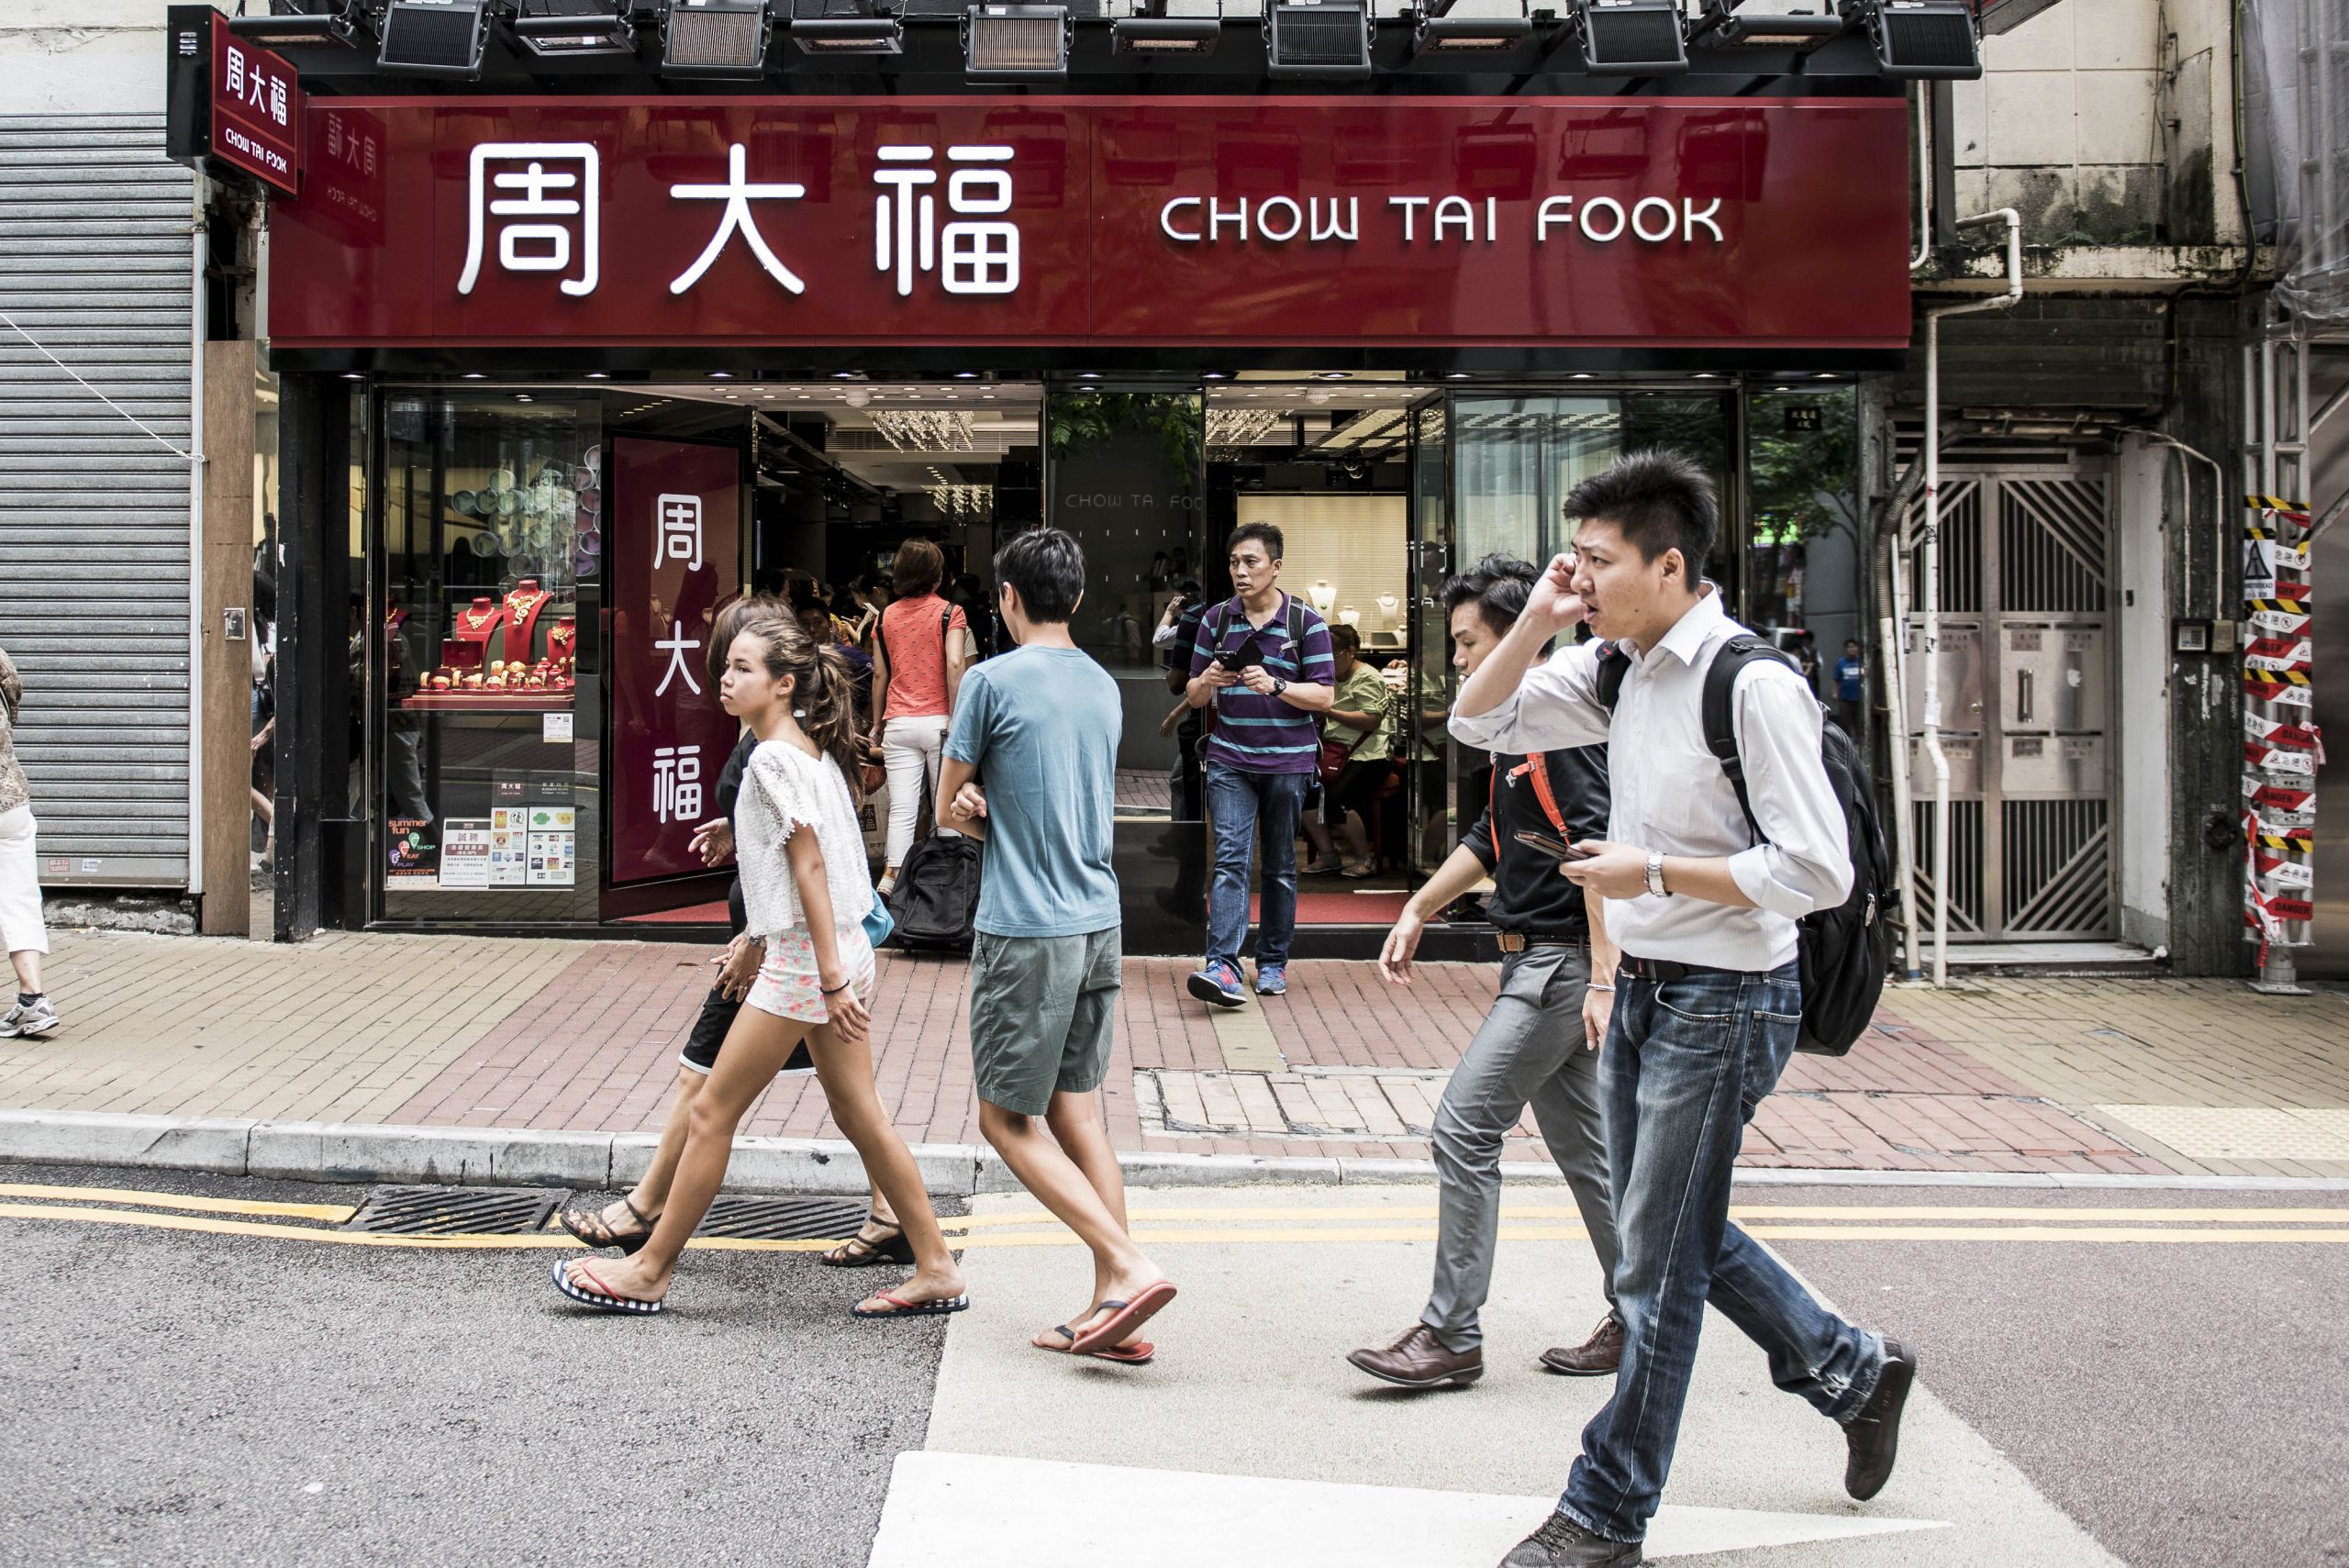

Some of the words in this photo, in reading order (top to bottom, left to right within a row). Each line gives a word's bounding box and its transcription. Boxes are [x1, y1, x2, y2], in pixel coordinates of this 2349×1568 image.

[226, 46, 286, 126] 周大福
[226, 128, 250, 153] CHOW
[251, 141, 264, 161] TAI
[266, 150, 287, 173] FOOK
[458, 142, 1020, 296] 周大福
[1161, 195, 1360, 241] CHOW
[1388, 195, 1497, 241] TAI
[1537, 195, 1725, 241] FOOK
[1065, 495, 1121, 507] CHOW
[1130, 495, 1159, 507] TA
[653, 494, 703, 824] 周大福
[2276, 901, 2310, 914] DANGER
